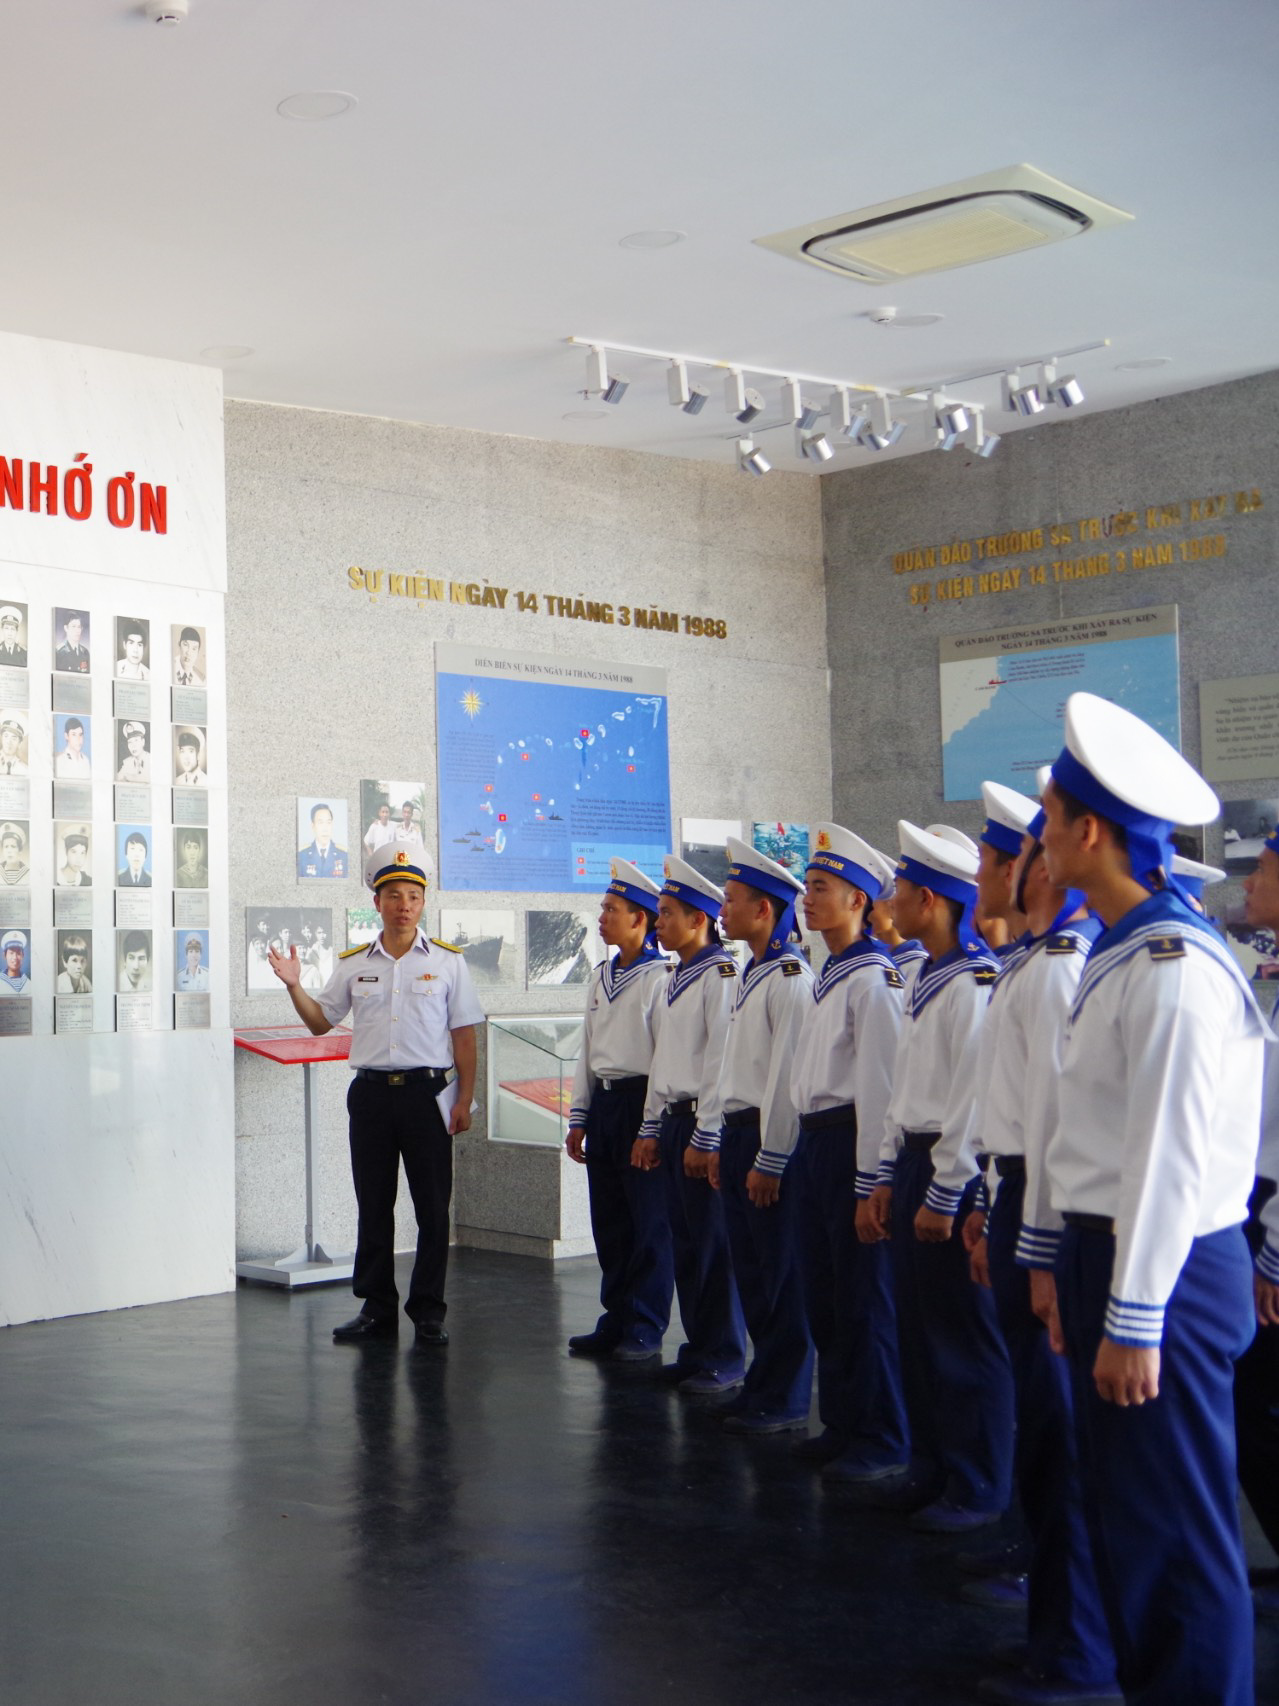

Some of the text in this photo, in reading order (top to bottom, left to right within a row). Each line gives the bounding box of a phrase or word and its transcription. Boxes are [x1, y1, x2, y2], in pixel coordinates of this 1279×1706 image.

[106, 470, 168, 535] ƠN
[1145, 504, 1181, 529] KHI
[1028, 565, 1047, 586] 14
[1116, 550, 1126, 573] 3
[1179, 535, 1227, 562] 1988
[347, 566, 728, 640] SỰ KIỆN NGÀY 14 THÁNG 3 NĂM 1988
[565, 668, 572, 677] 14
[598, 672, 602, 680] 3
[620, 675, 633, 683] 1988
